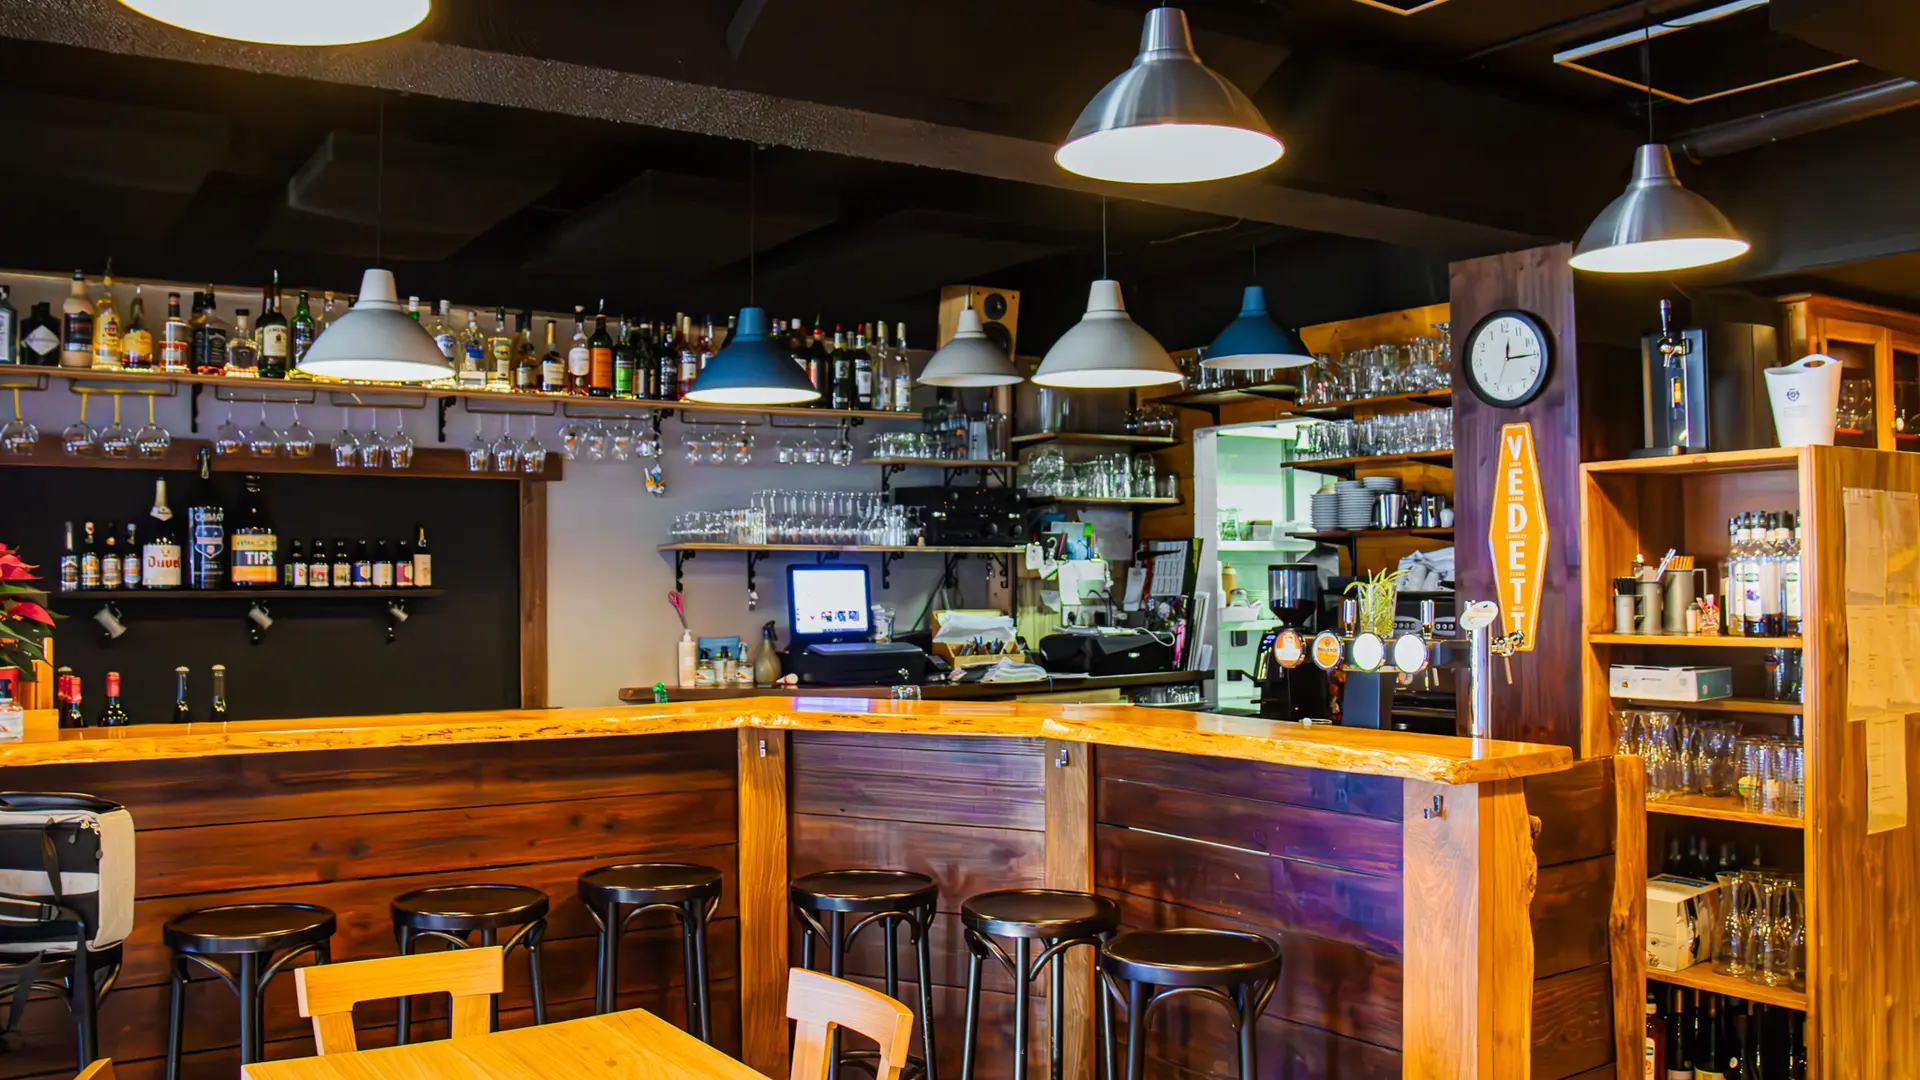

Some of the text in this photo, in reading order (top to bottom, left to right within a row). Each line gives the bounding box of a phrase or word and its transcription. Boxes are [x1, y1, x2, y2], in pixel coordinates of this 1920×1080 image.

[1500, 319, 1510, 334] 12
[1514, 326, 1522, 337] 11
[1476, 341, 1486, 353] 2
[1474, 358, 1483, 368] 3
[1529, 365, 1537, 377] 8
[1520, 377, 1528, 389] 7
[1507, 384, 1514, 396] 6
[194, 512, 224, 523] CHIMAY
[1506, 434, 1528, 632] VEDETT
[244, 551, 274, 565] TIPS
